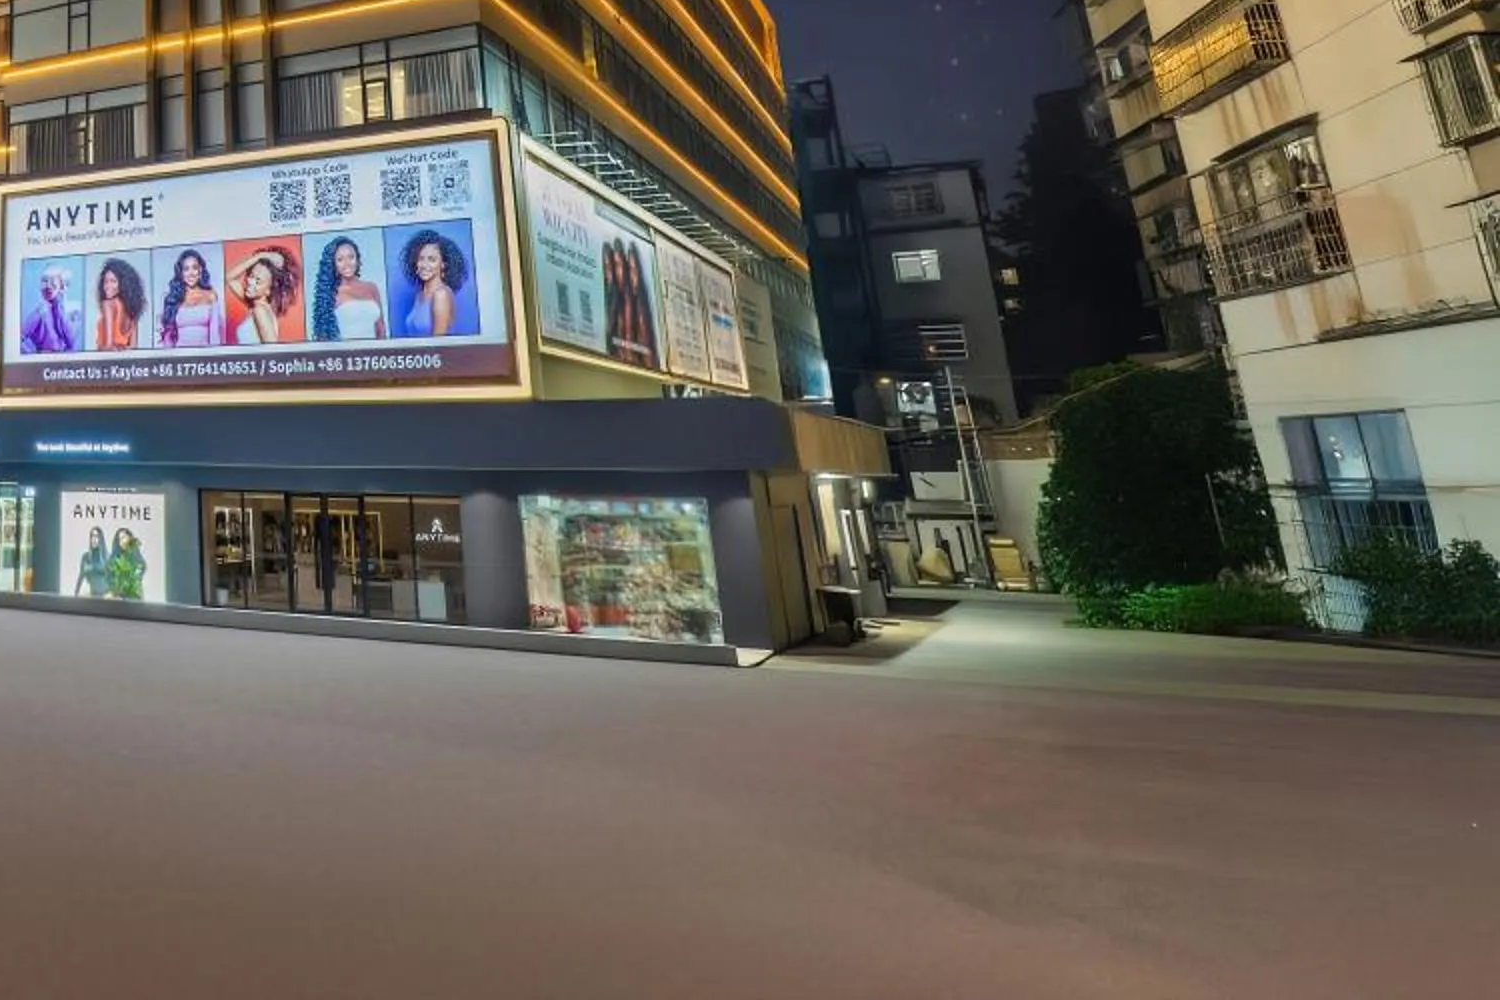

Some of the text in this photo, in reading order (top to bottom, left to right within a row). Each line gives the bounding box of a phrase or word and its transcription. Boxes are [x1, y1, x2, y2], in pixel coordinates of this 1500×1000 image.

[386, 147, 459, 166] WeChat Code
[26, 196, 154, 231] ANYTIME
[43, 366, 86, 380] Contact
[269, 358, 315, 376] Sophia
[317, 357, 343, 372] +86
[73, 503, 152, 520] ANYTIME
